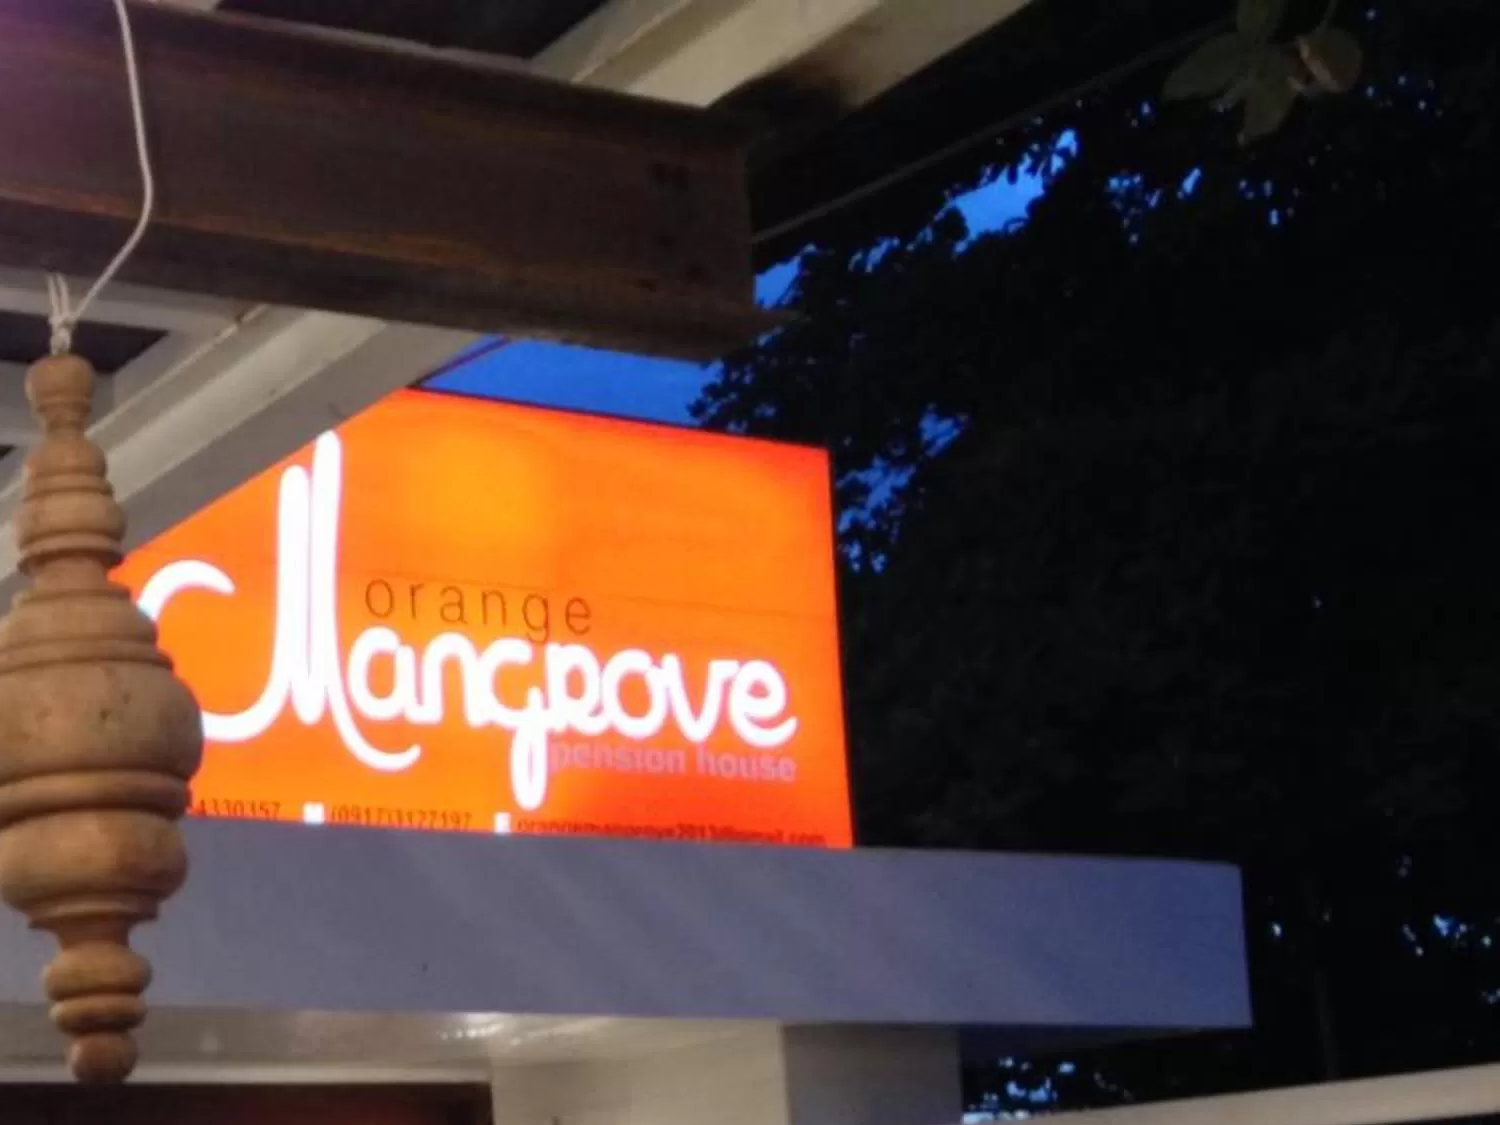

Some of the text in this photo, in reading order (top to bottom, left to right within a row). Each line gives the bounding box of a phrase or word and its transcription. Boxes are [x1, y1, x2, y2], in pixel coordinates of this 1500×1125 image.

[137, 429, 797, 810] Mangrove
[365, 577, 593, 643] orange
[548, 738, 798, 783] pension house
